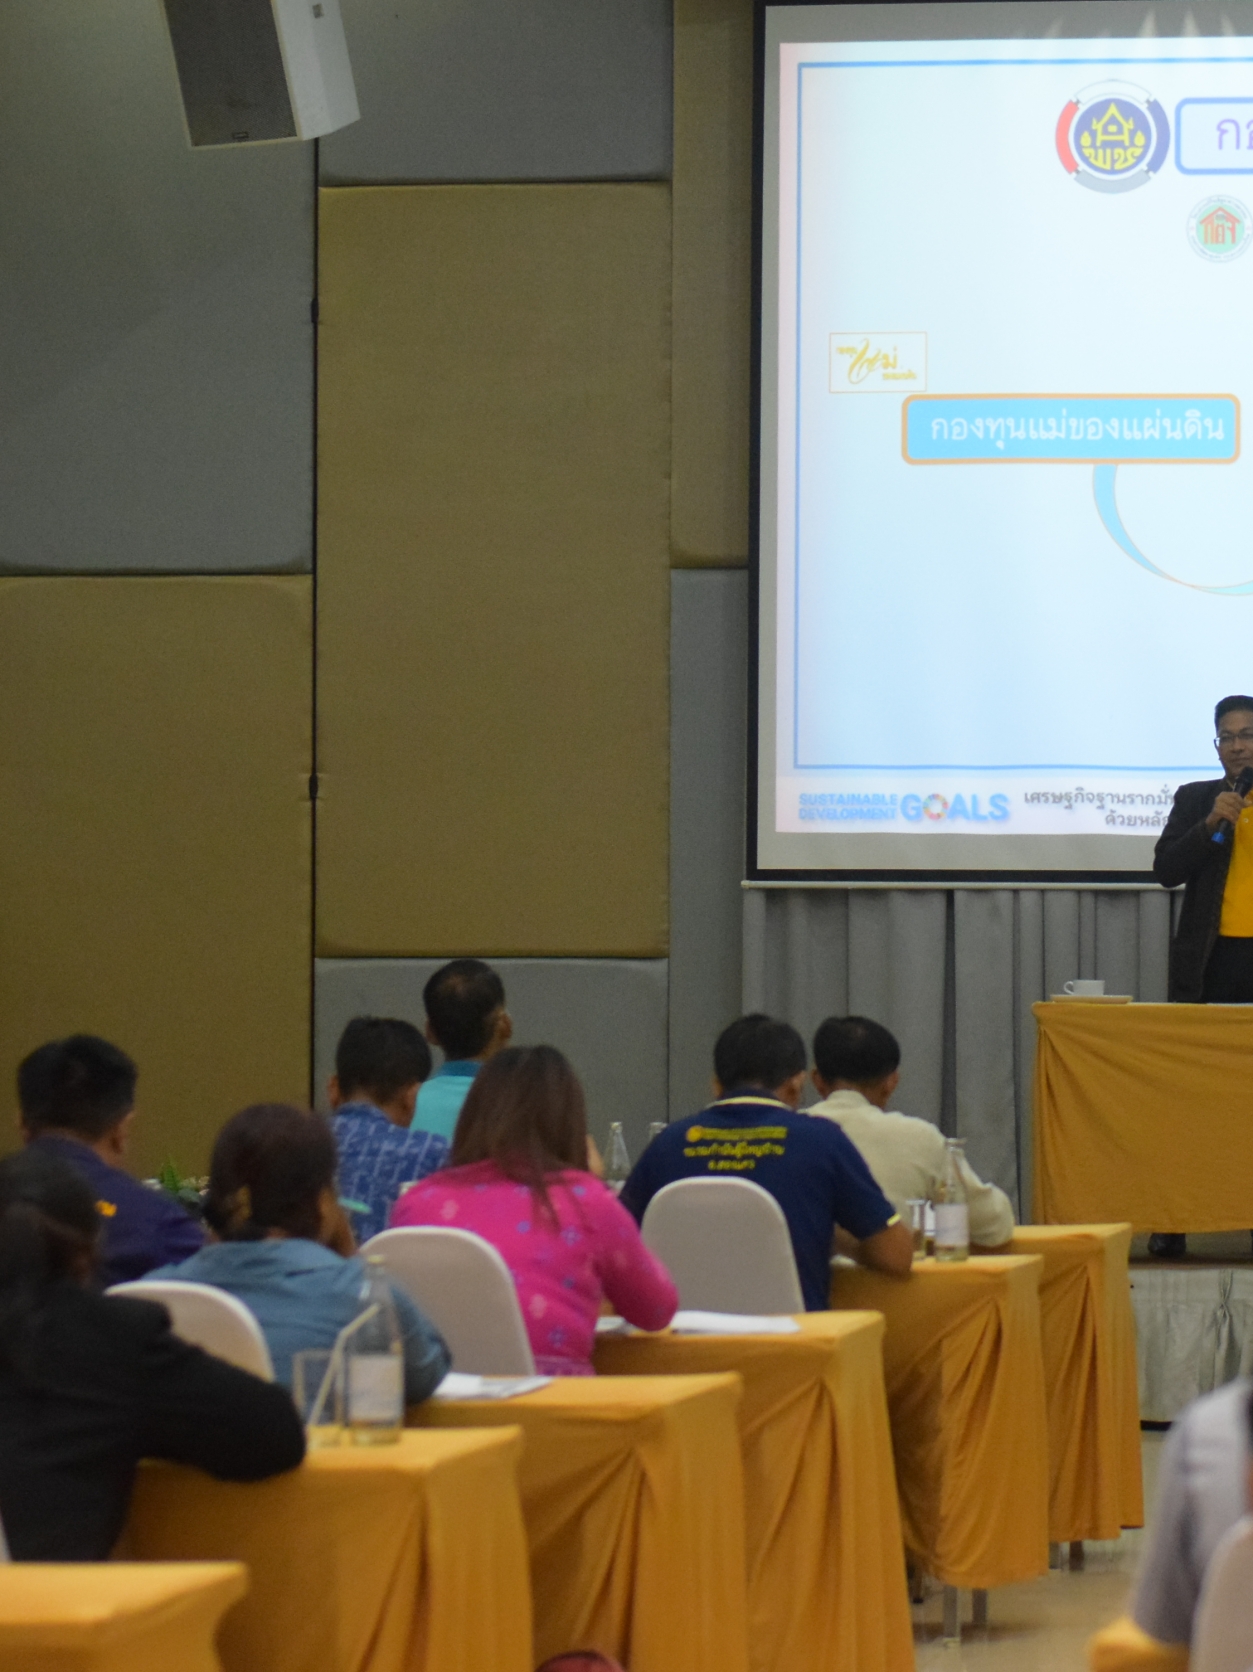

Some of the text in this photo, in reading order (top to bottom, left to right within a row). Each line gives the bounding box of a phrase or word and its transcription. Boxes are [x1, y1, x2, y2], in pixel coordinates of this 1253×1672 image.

[931, 408, 1226, 450] กองทุนแม่ของแผ่นดิน
[799, 792, 898, 806] SUSTAINABLE
[899, 792, 1009, 822] GOALS
[798, 807, 898, 821] DEVELOPMENT
